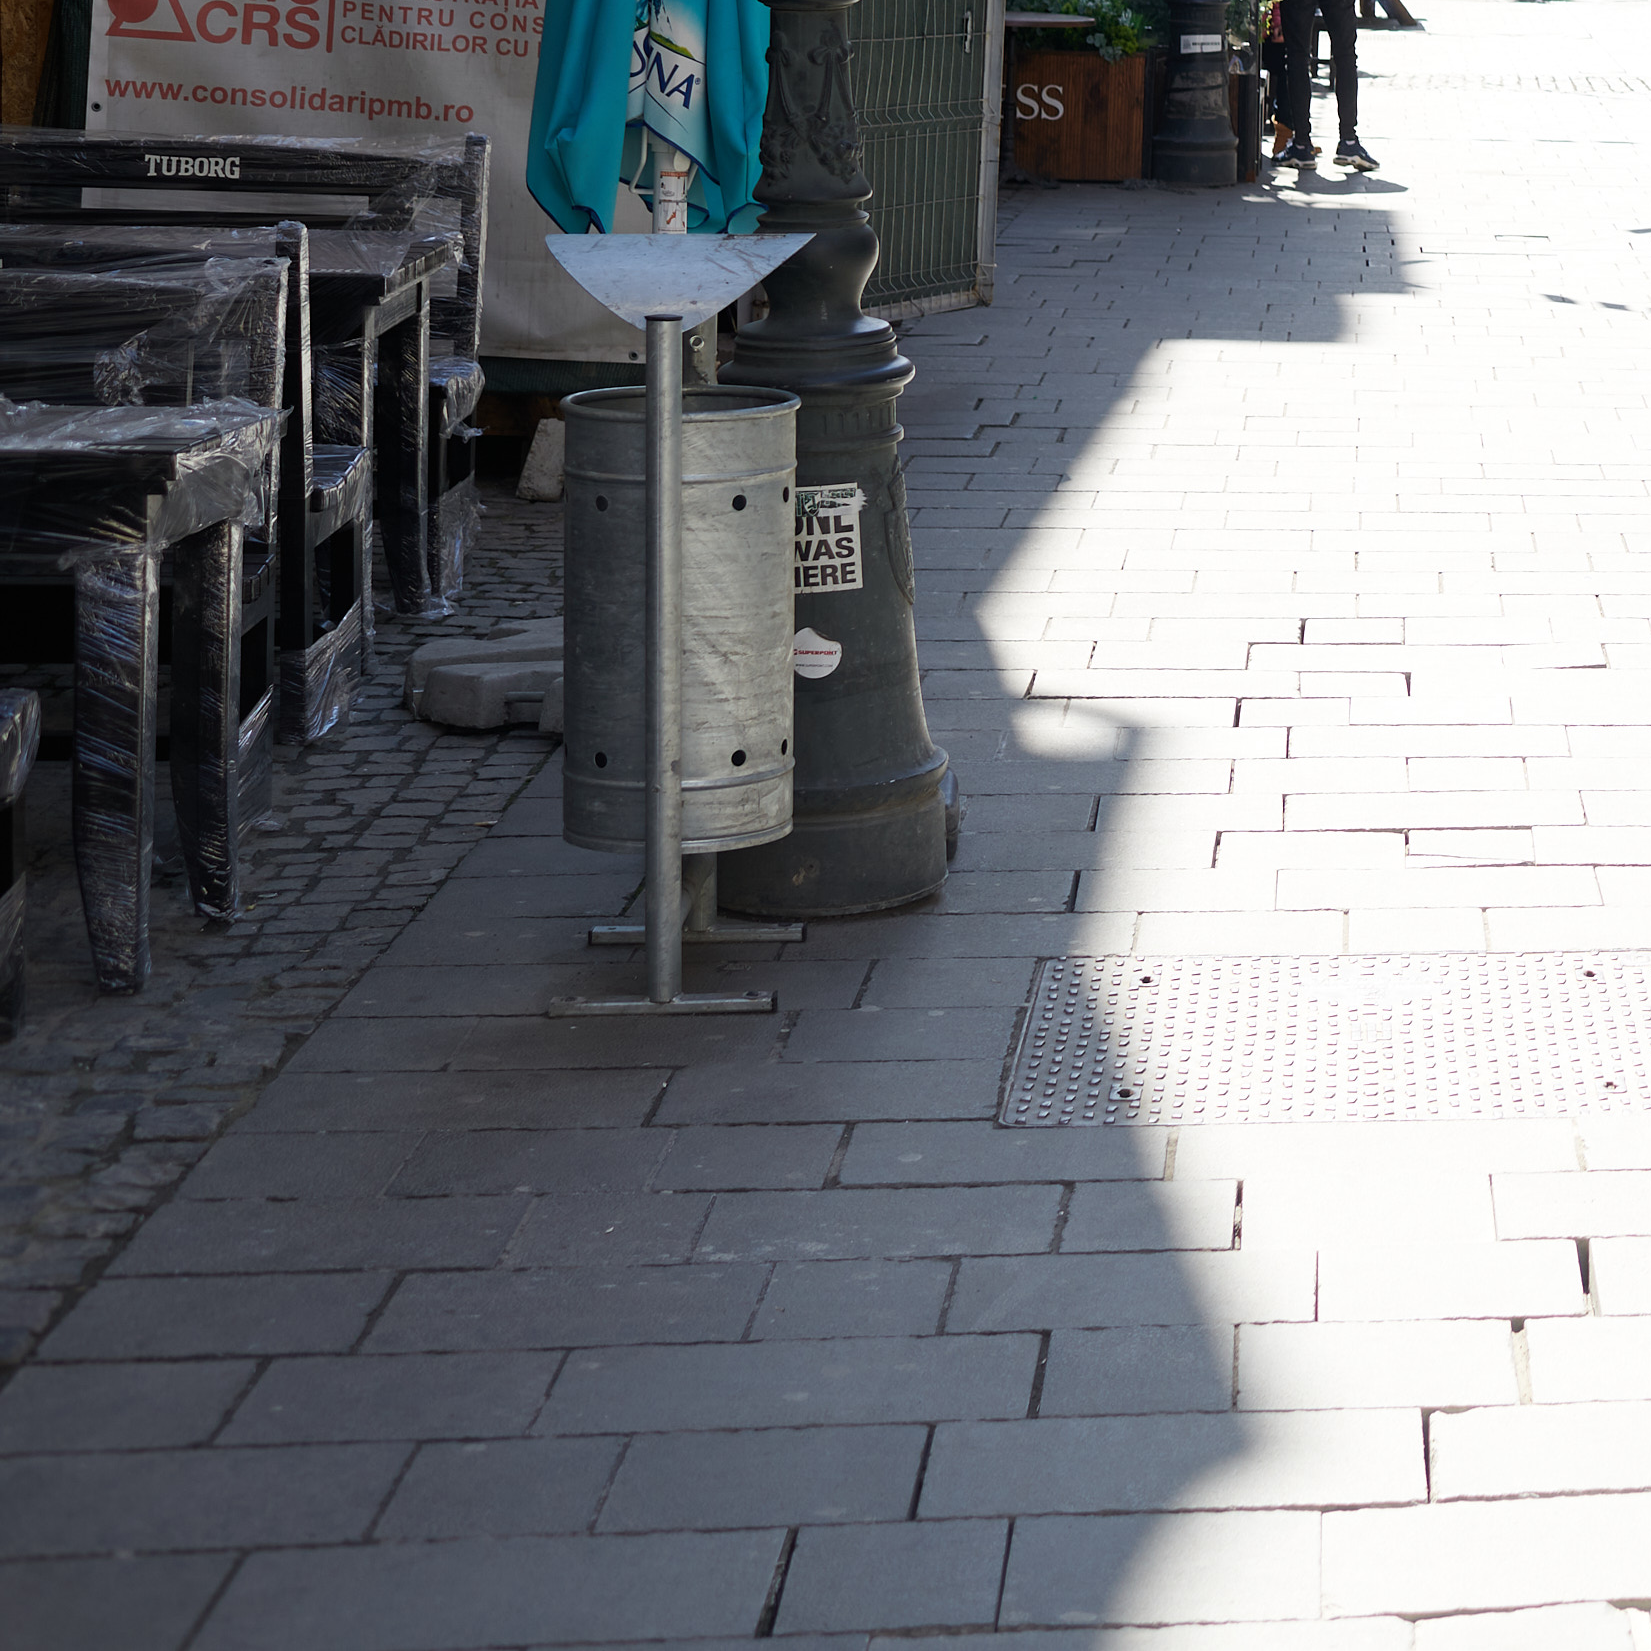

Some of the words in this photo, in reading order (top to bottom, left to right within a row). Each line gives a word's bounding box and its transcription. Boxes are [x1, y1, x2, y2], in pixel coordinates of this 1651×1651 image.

[196, 0, 321, 50] CRS
[342, 1, 455, 28] PENTRU
[468, 11, 544, 35] CONS
[340, 22, 488, 55] CLĂDIRILOR
[495, 35, 528, 57] CU
[105, 79, 475, 123] www.consolidaripmb.ro
[1015, 83, 1064, 121] SS
[145, 153, 241, 179] TUBORG
